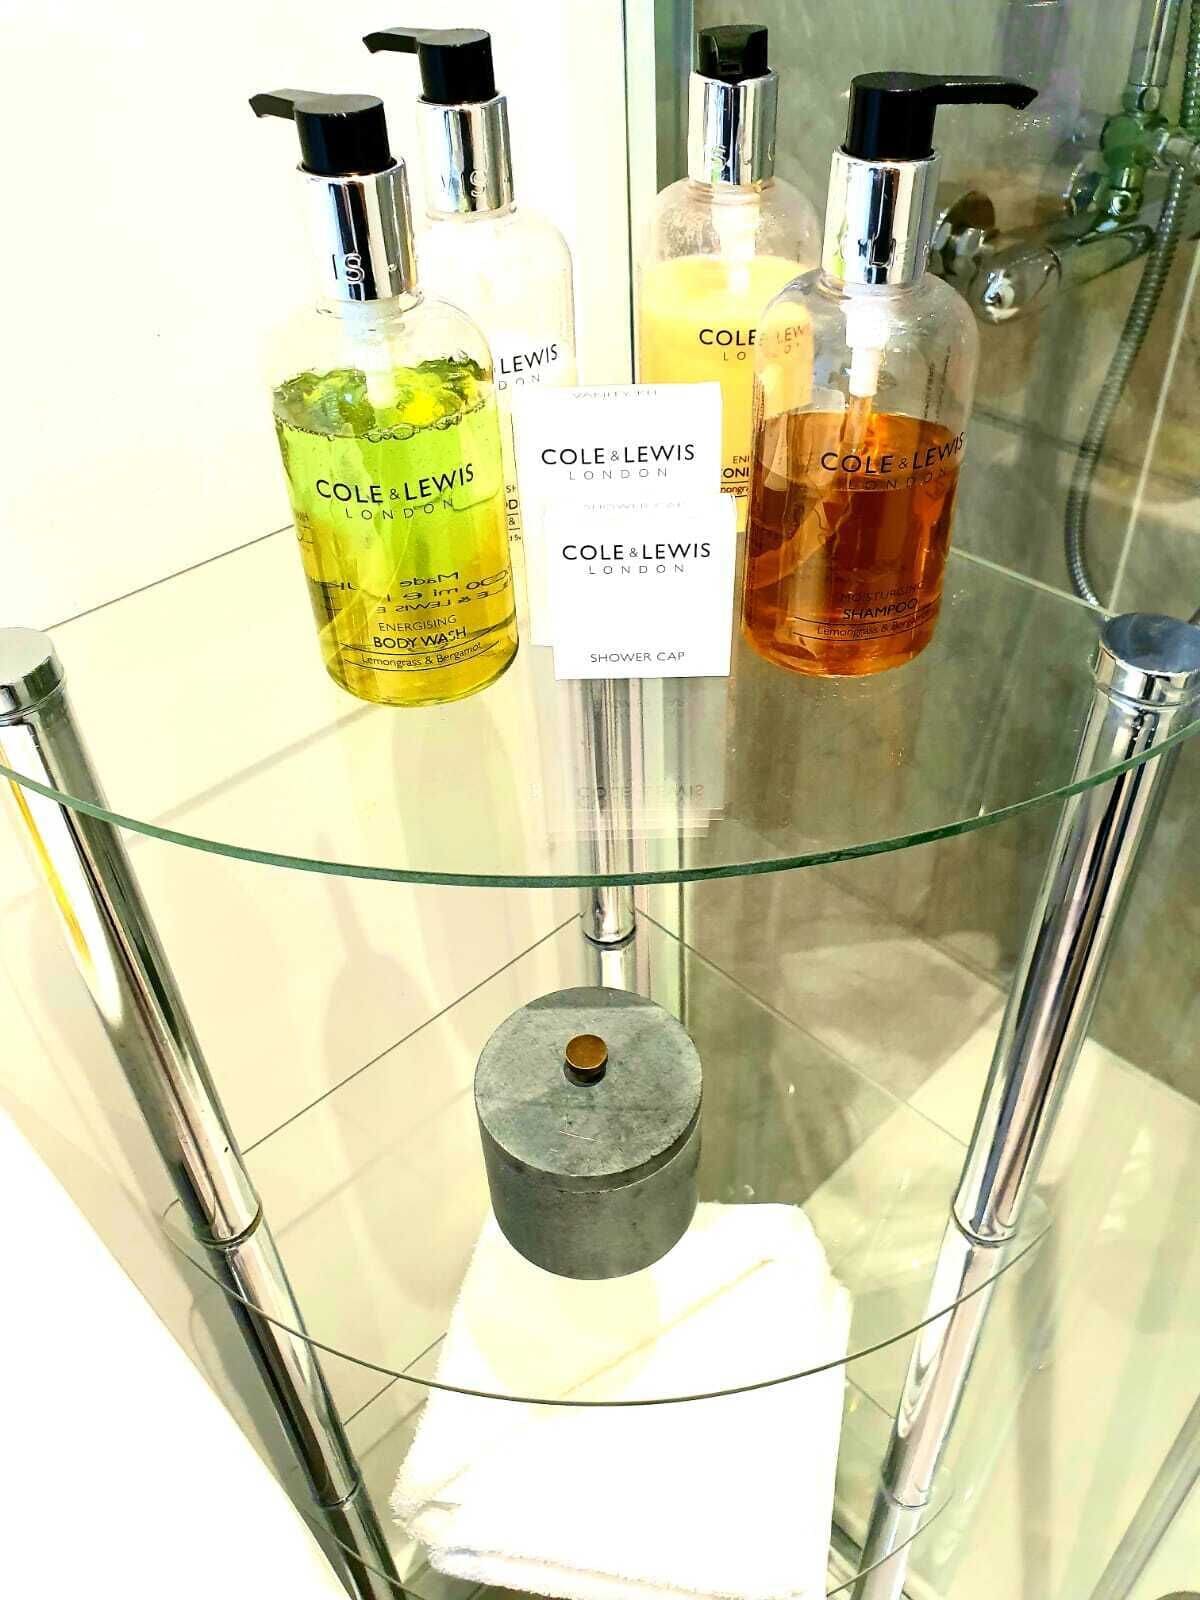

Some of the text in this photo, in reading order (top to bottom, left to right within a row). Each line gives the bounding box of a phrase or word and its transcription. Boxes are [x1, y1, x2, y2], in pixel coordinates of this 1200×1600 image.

[699, 328, 757, 346] COLE
[500, 343, 558, 375] LEWIS
[541, 443, 695, 465] COLE & LEWIS
[821, 431, 966, 474] COLE & LEWIS
[316, 463, 475, 504] COLE & LEWIS
[568, 467, 668, 481] LONDON
[345, 498, 455, 520] LONDON
[562, 542, 711, 561] COLE & LEWIS
[588, 563, 686, 576] LONDON
[843, 597, 919, 620] SHAMPOO
[378, 614, 457, 633] ENERGISING
[373, 626, 467, 649] BODY WASH
[361, 653, 422, 667] Lemongrass
[425, 655, 433, 665] &
[590, 651, 685, 663] SHOWER CAP
